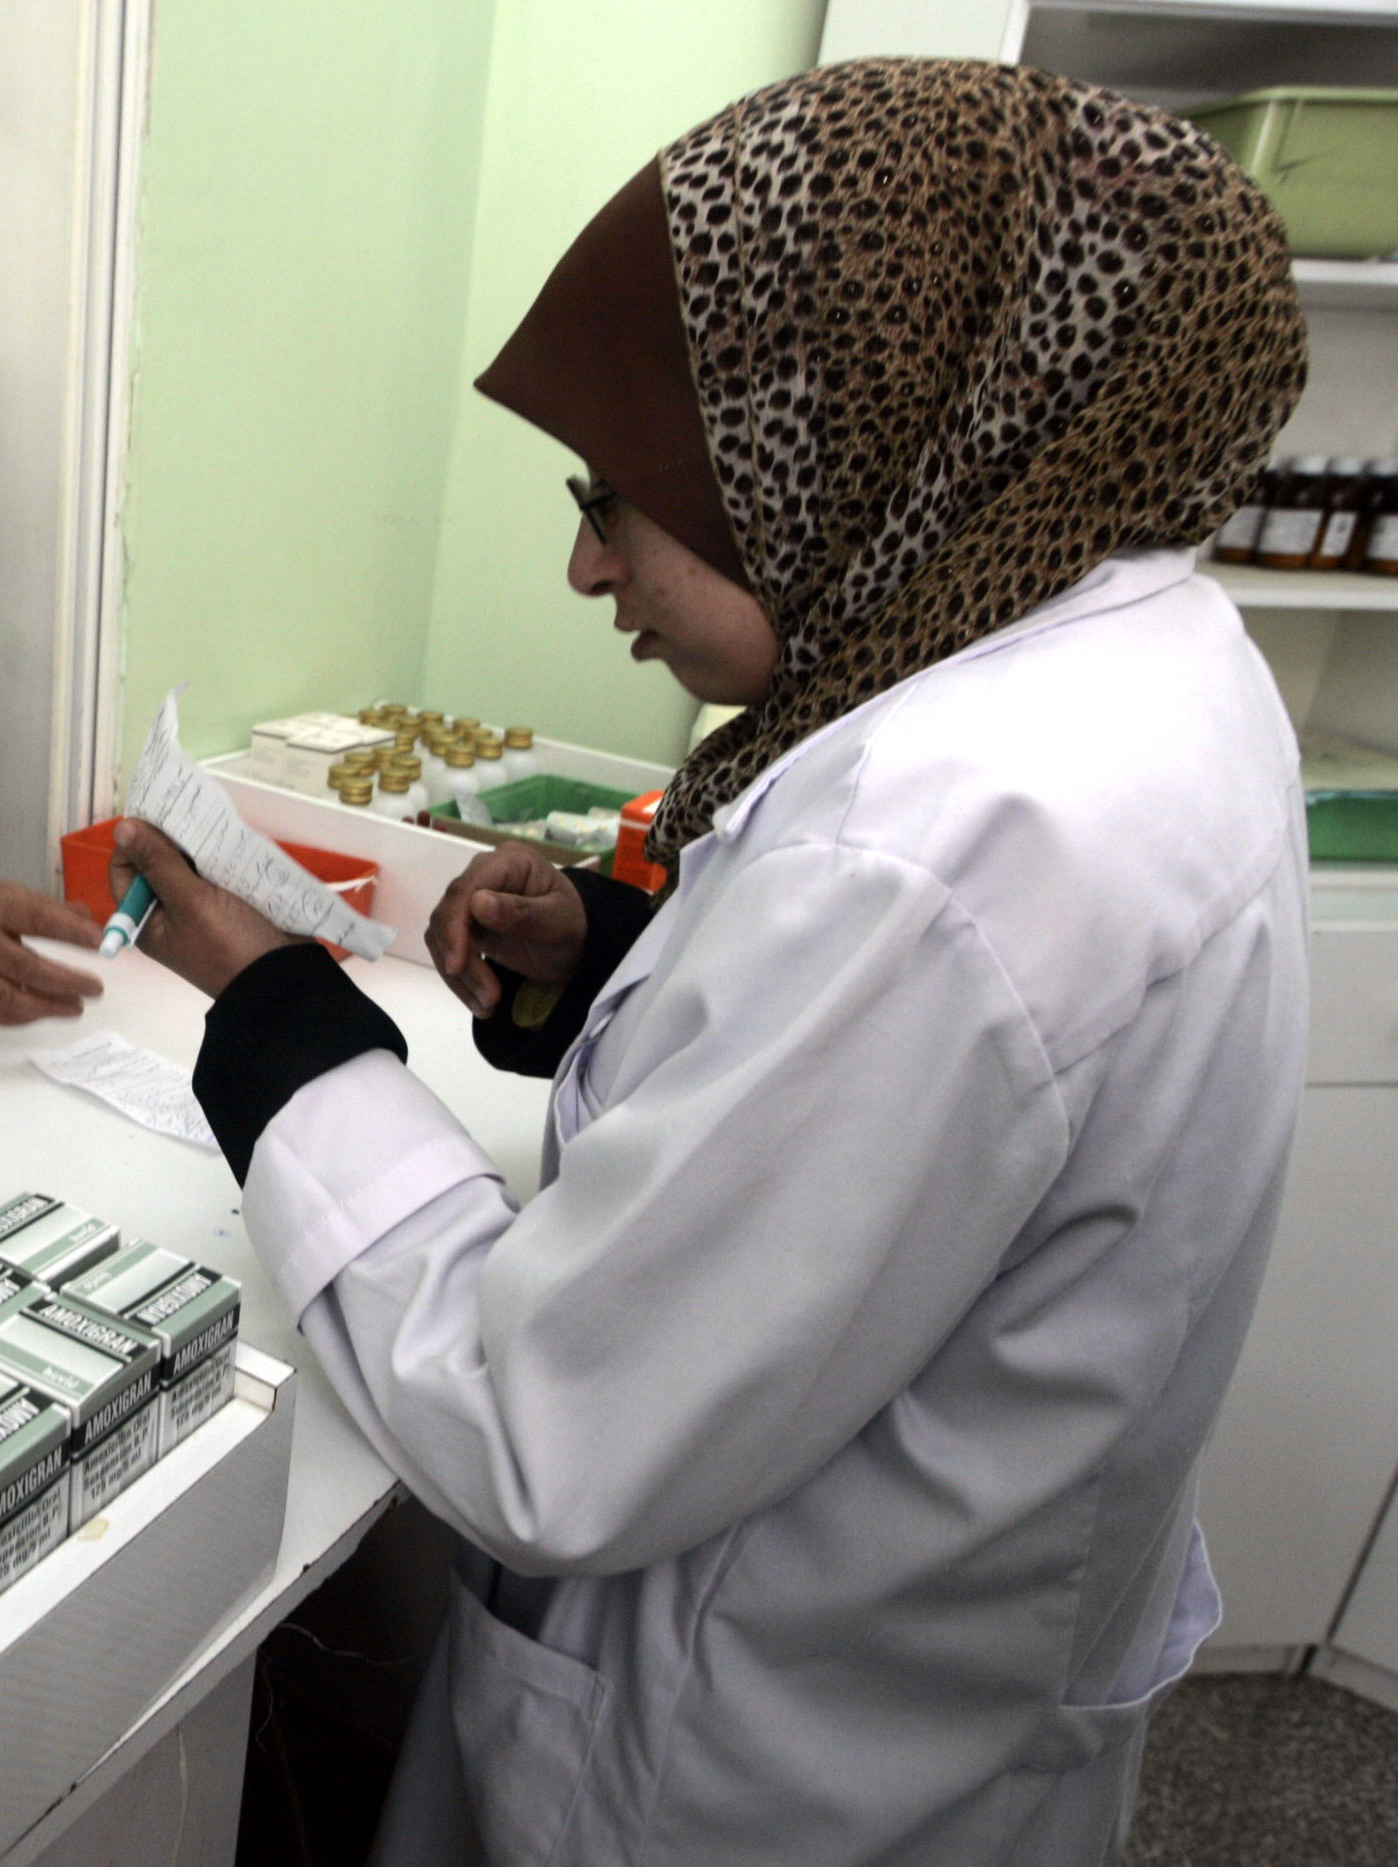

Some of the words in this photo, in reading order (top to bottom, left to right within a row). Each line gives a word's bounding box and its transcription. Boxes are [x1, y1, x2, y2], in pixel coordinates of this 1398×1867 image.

[38, 1303, 139, 1354] AMOXIGRAN
[173, 1309, 235, 1375] AMOXIGRAN
[84, 1370, 152, 1445] AMOXIGRAN
